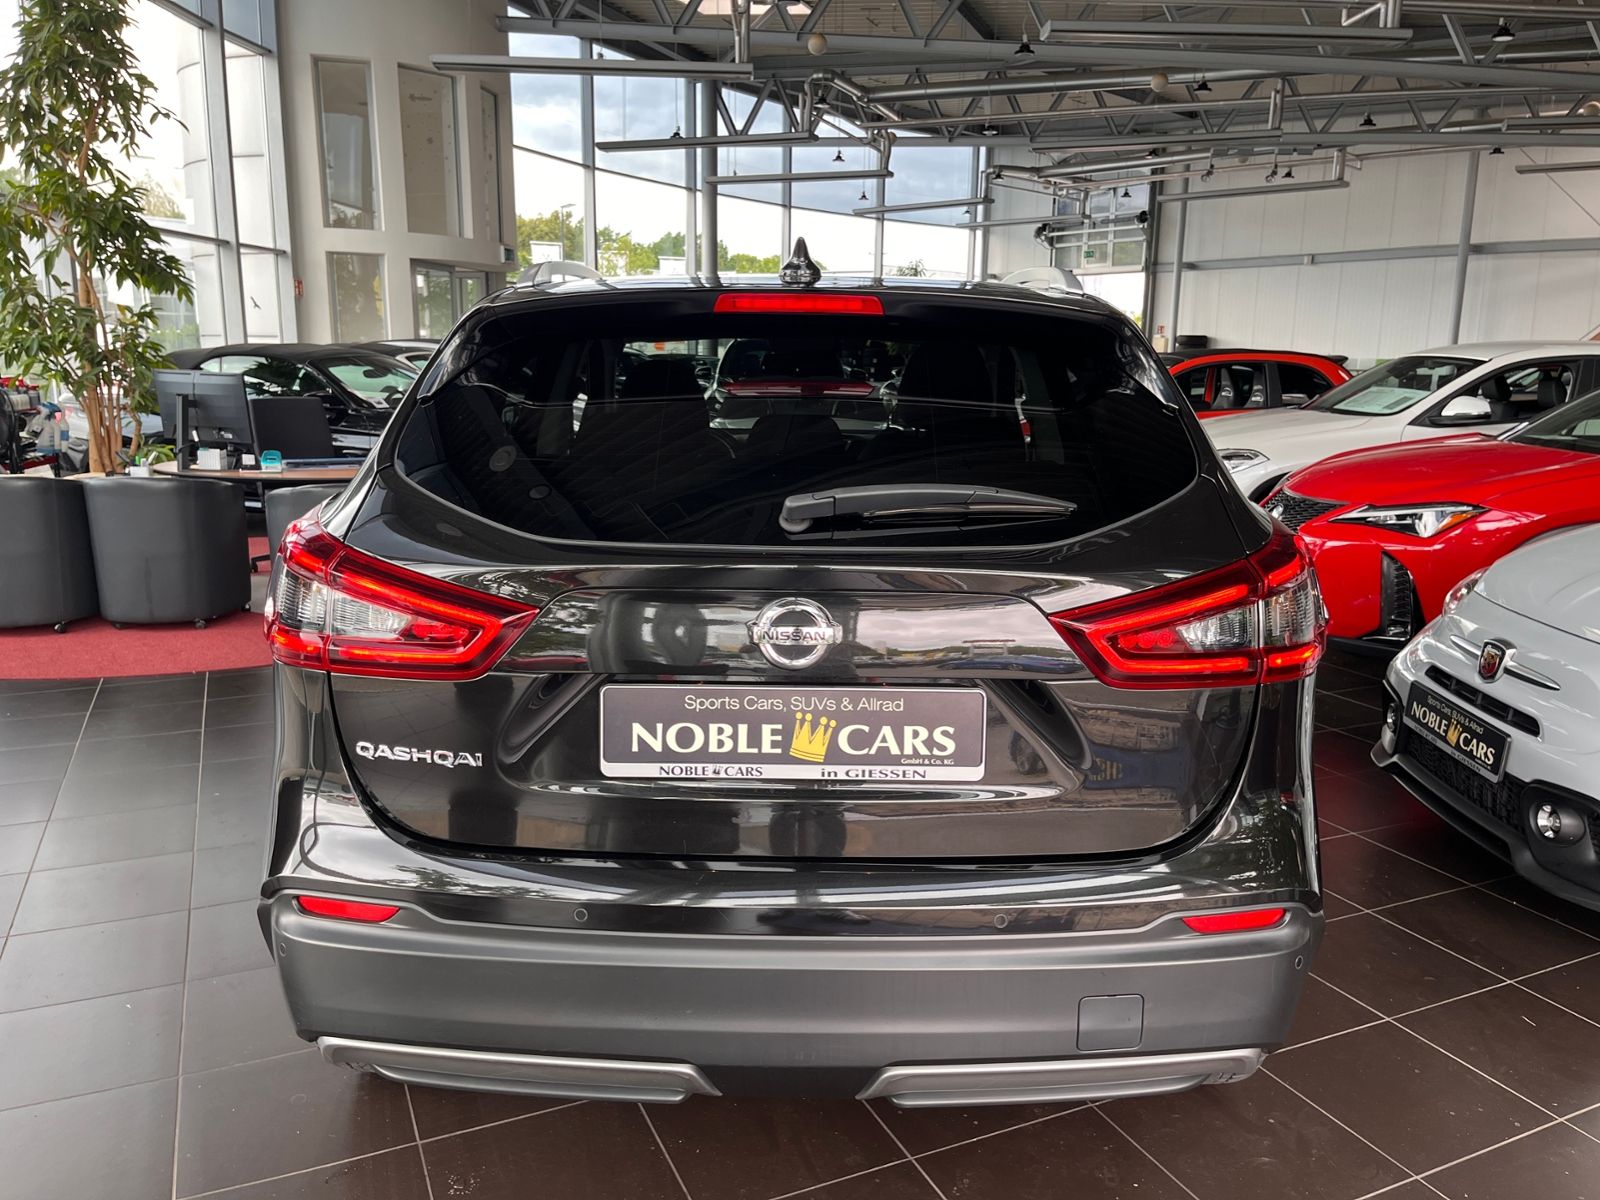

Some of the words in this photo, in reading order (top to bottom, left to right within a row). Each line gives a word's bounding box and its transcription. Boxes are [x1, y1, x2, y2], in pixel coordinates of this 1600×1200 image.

[762, 631, 826, 641] NISSAN
[684, 695, 740, 712] Sports
[744, 695, 787, 712] Cars,
[790, 696, 837, 711] SUVs
[840, 697, 854, 711] &
[857, 697, 904, 712] Allrad
[631, 722, 783, 755] NOBLE
[838, 724, 957, 756] CARS
[1411, 701, 1448, 736] NOBLE
[1459, 732, 1495, 765] CARS
[355, 741, 483, 768] QASHQAI
[659, 766, 709, 776] NOBLE
[724, 767, 763, 777] CARS
[821, 768, 838, 778] in
[845, 769, 927, 779] GIESSEN
